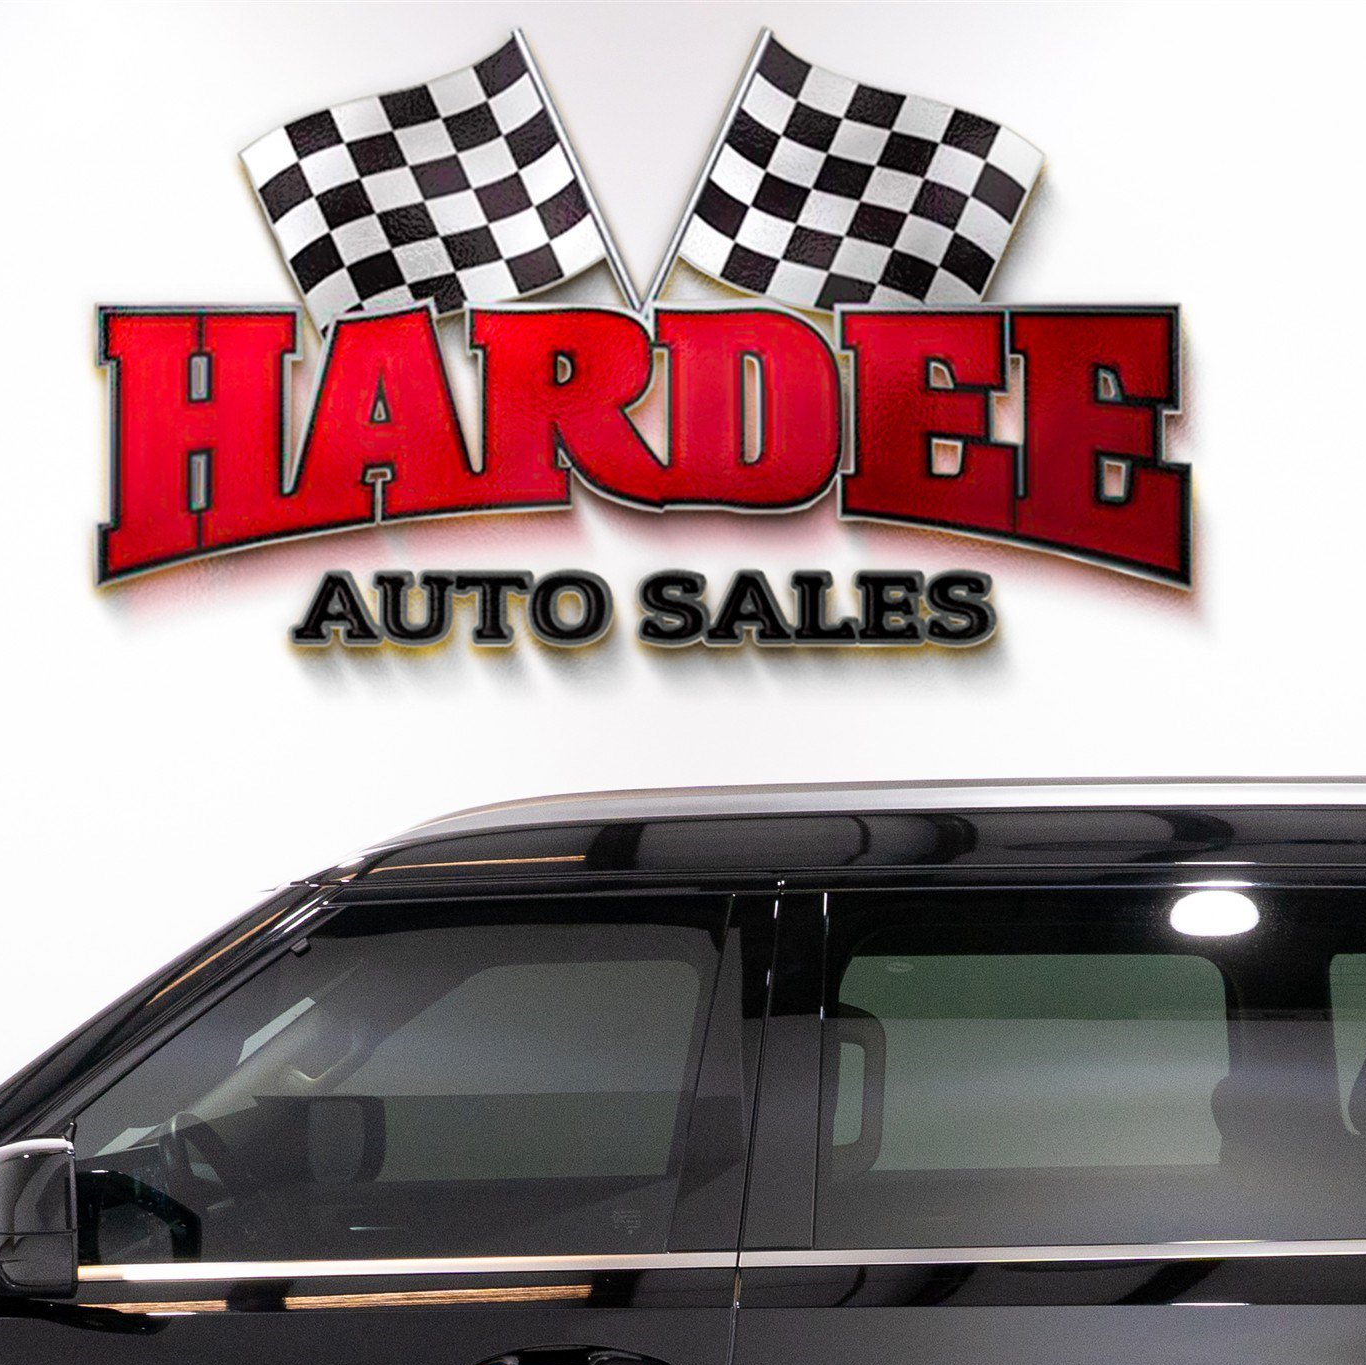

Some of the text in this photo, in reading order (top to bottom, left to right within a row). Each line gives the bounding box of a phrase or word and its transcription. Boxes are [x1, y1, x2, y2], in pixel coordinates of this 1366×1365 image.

[94, 302, 1193, 589] HARDEE
[292, 570, 998, 647] AUTO SALES
